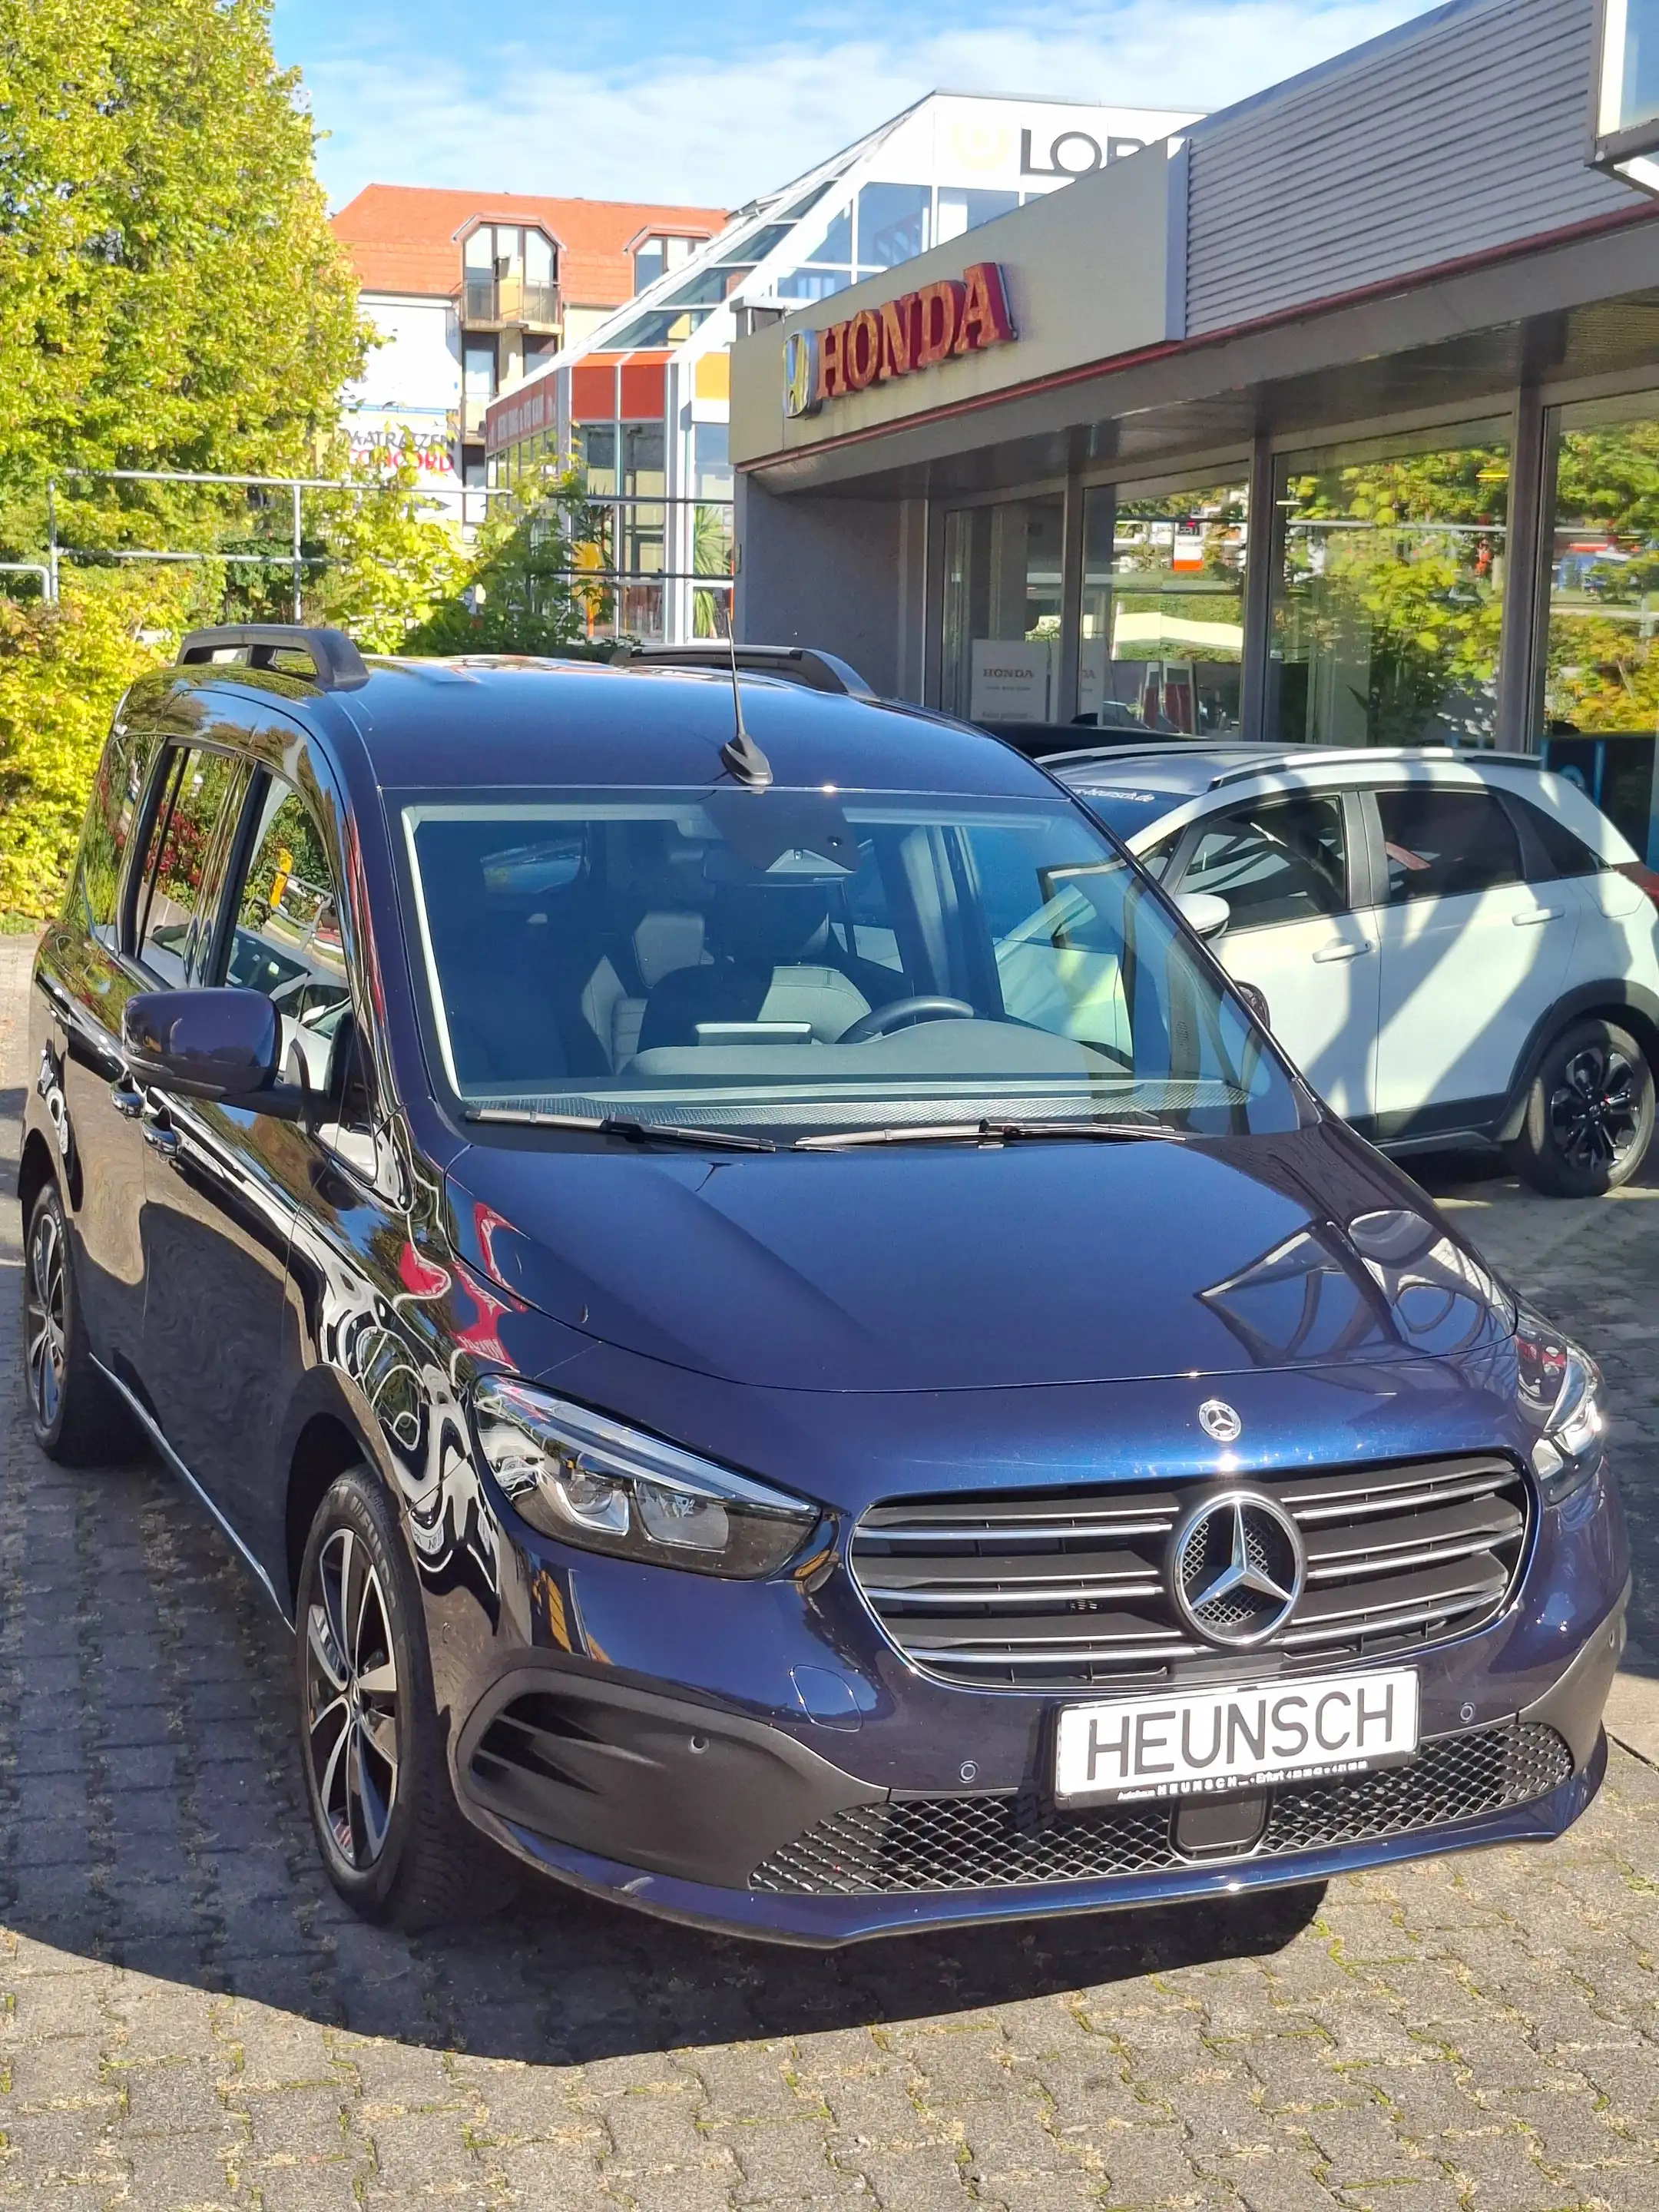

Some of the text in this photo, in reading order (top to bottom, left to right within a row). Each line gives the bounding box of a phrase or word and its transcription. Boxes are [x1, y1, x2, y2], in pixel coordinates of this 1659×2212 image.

[816, 262, 1009, 400] HONDA
[982, 668, 1034, 679] HONDA
[1087, 1684, 1394, 1780] HEUNSCH
[1157, 1776, 1237, 1796] HEUNSCH
